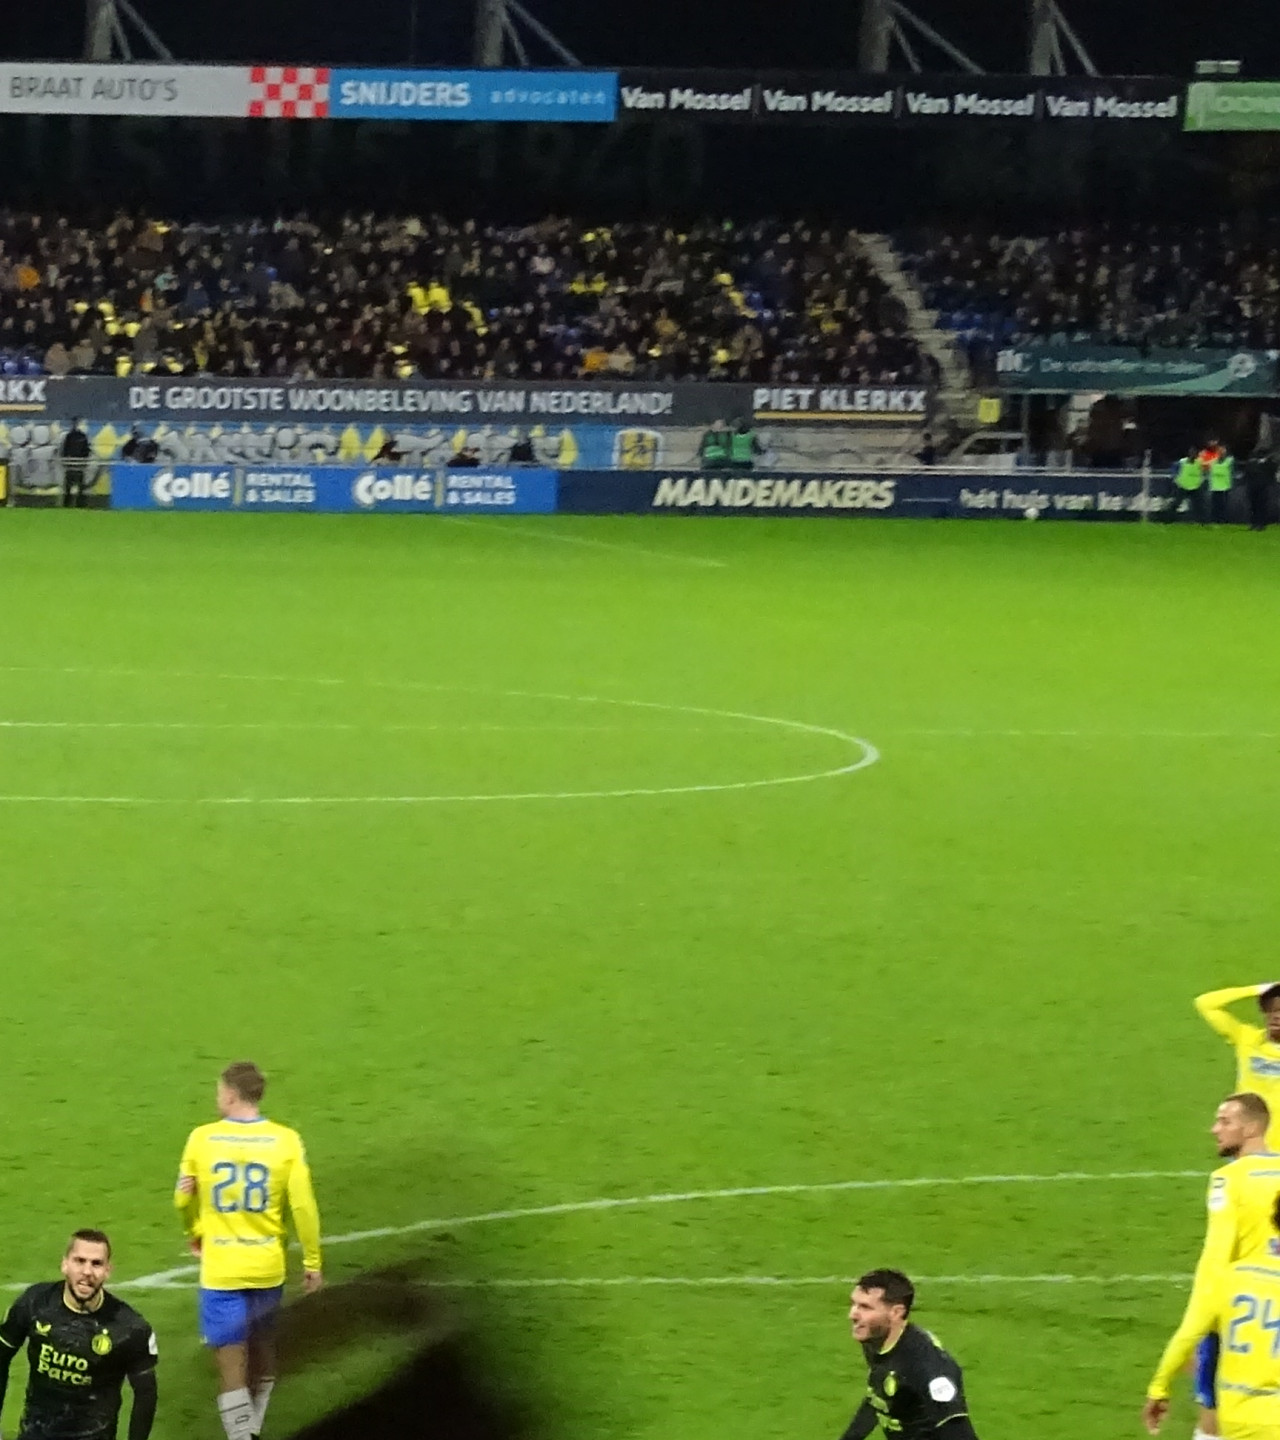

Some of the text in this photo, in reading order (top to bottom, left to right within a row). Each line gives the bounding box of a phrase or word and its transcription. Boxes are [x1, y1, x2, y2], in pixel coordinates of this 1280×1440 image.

[9, 76, 83, 98] BRAAT
[90, 78, 178, 101] AUTO'S
[620, 86, 753, 111] Van Mossel
[762, 89, 894, 113] Van Mossel
[906, 92, 1035, 116] Van Mossel
[1045, 95, 1089, 117] Van
[1093, 95, 1178, 118] Mossel
[128, 386, 160, 409] DE
[165, 386, 285, 411] GROOTSTE
[477, 390, 526, 413] VAN
[752, 388, 927, 412] PIET KLERKX
[151, 472, 231, 507] Collé
[353, 474, 434, 508] Collé
[651, 477, 898, 509] MANDEMAKERS
[211, 1161, 271, 1214] 28
[1229, 1293, 1280, 1359] 24
[39, 1343, 89, 1372] Euro
